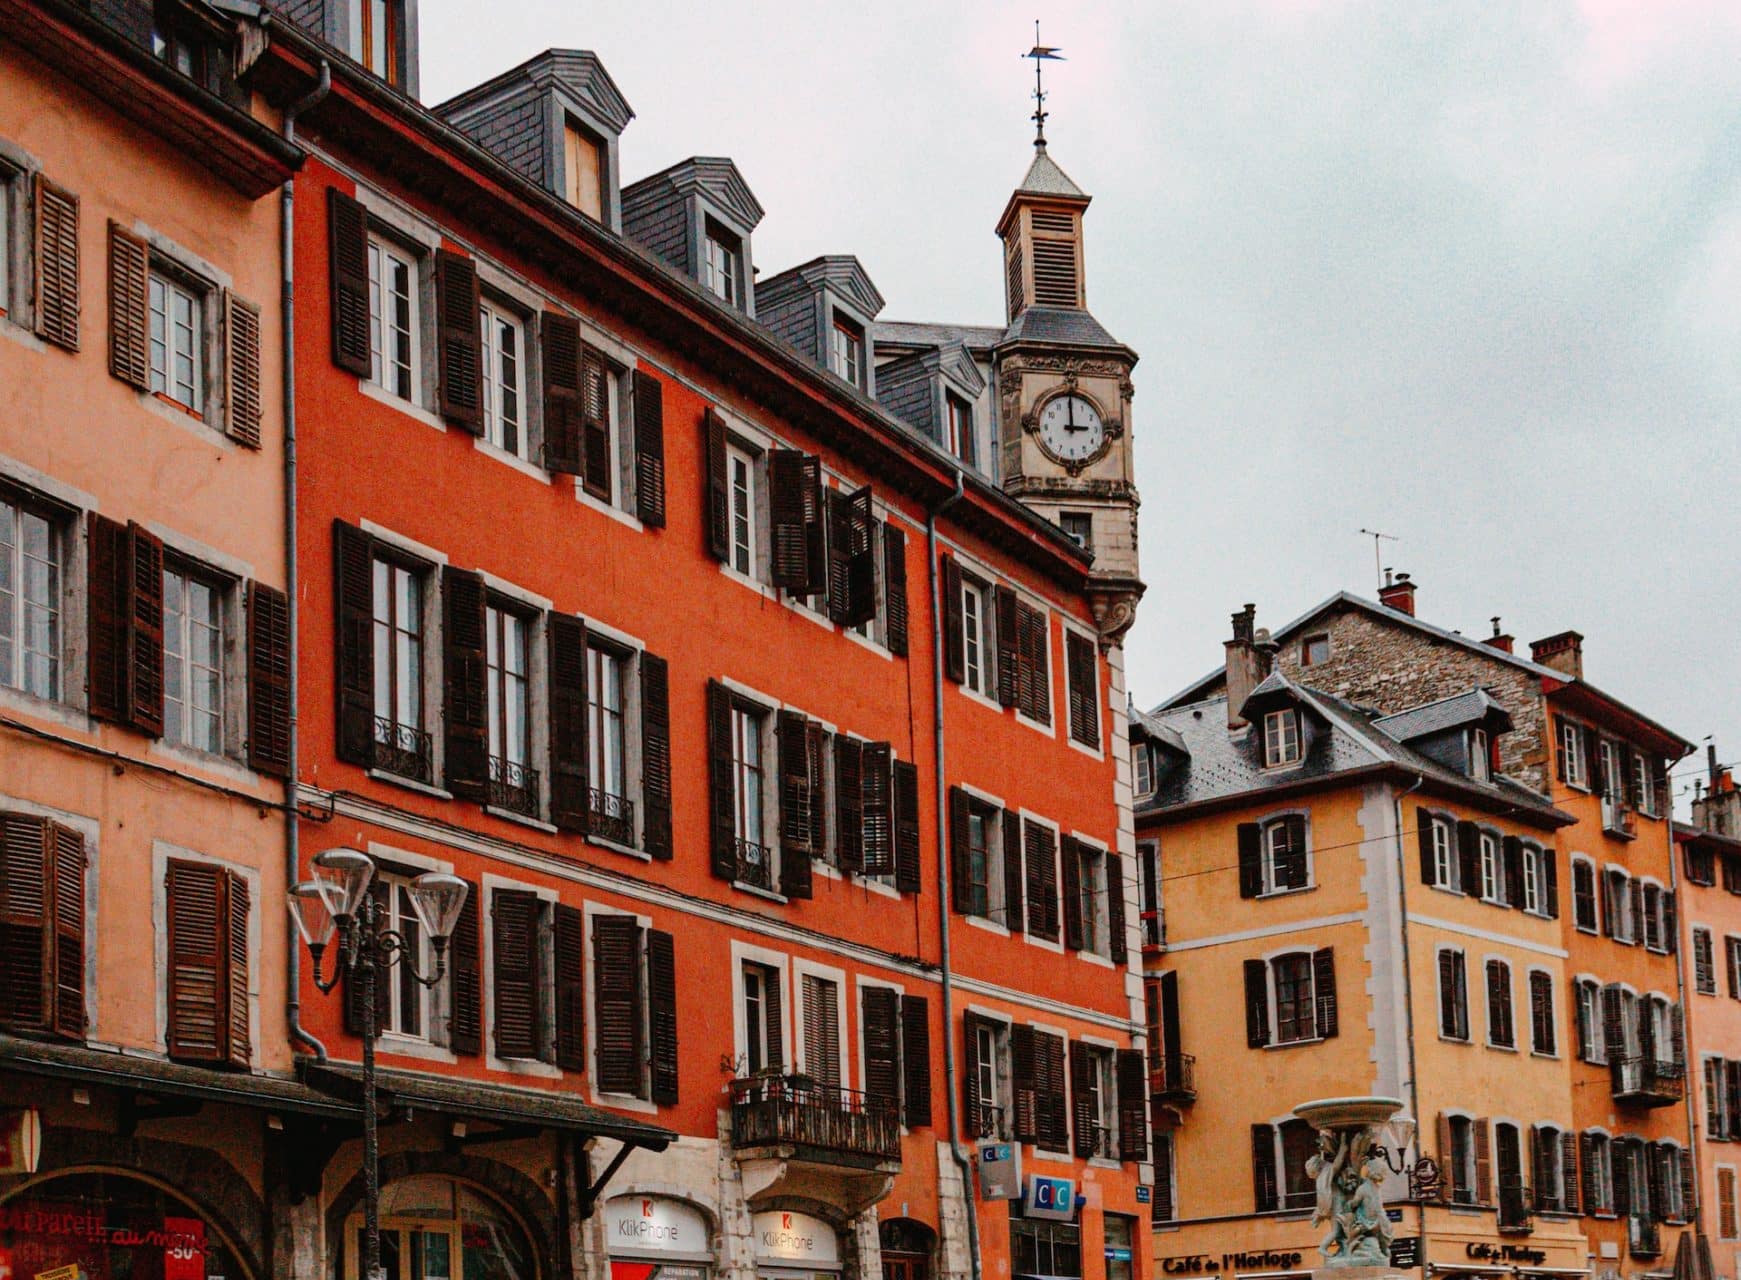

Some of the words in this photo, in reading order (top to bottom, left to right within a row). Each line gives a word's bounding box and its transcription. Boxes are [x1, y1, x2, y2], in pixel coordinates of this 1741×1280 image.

[1038, 1184, 1067, 1206] CIC
[618, 1219, 679, 1241] KlikPhone
[762, 1232, 813, 1250] KlikPhone
[1163, 1257, 1202, 1273] Café
[1205, 1260, 1219, 1271] de
[1223, 1252, 1302, 1270] l'Horloge
